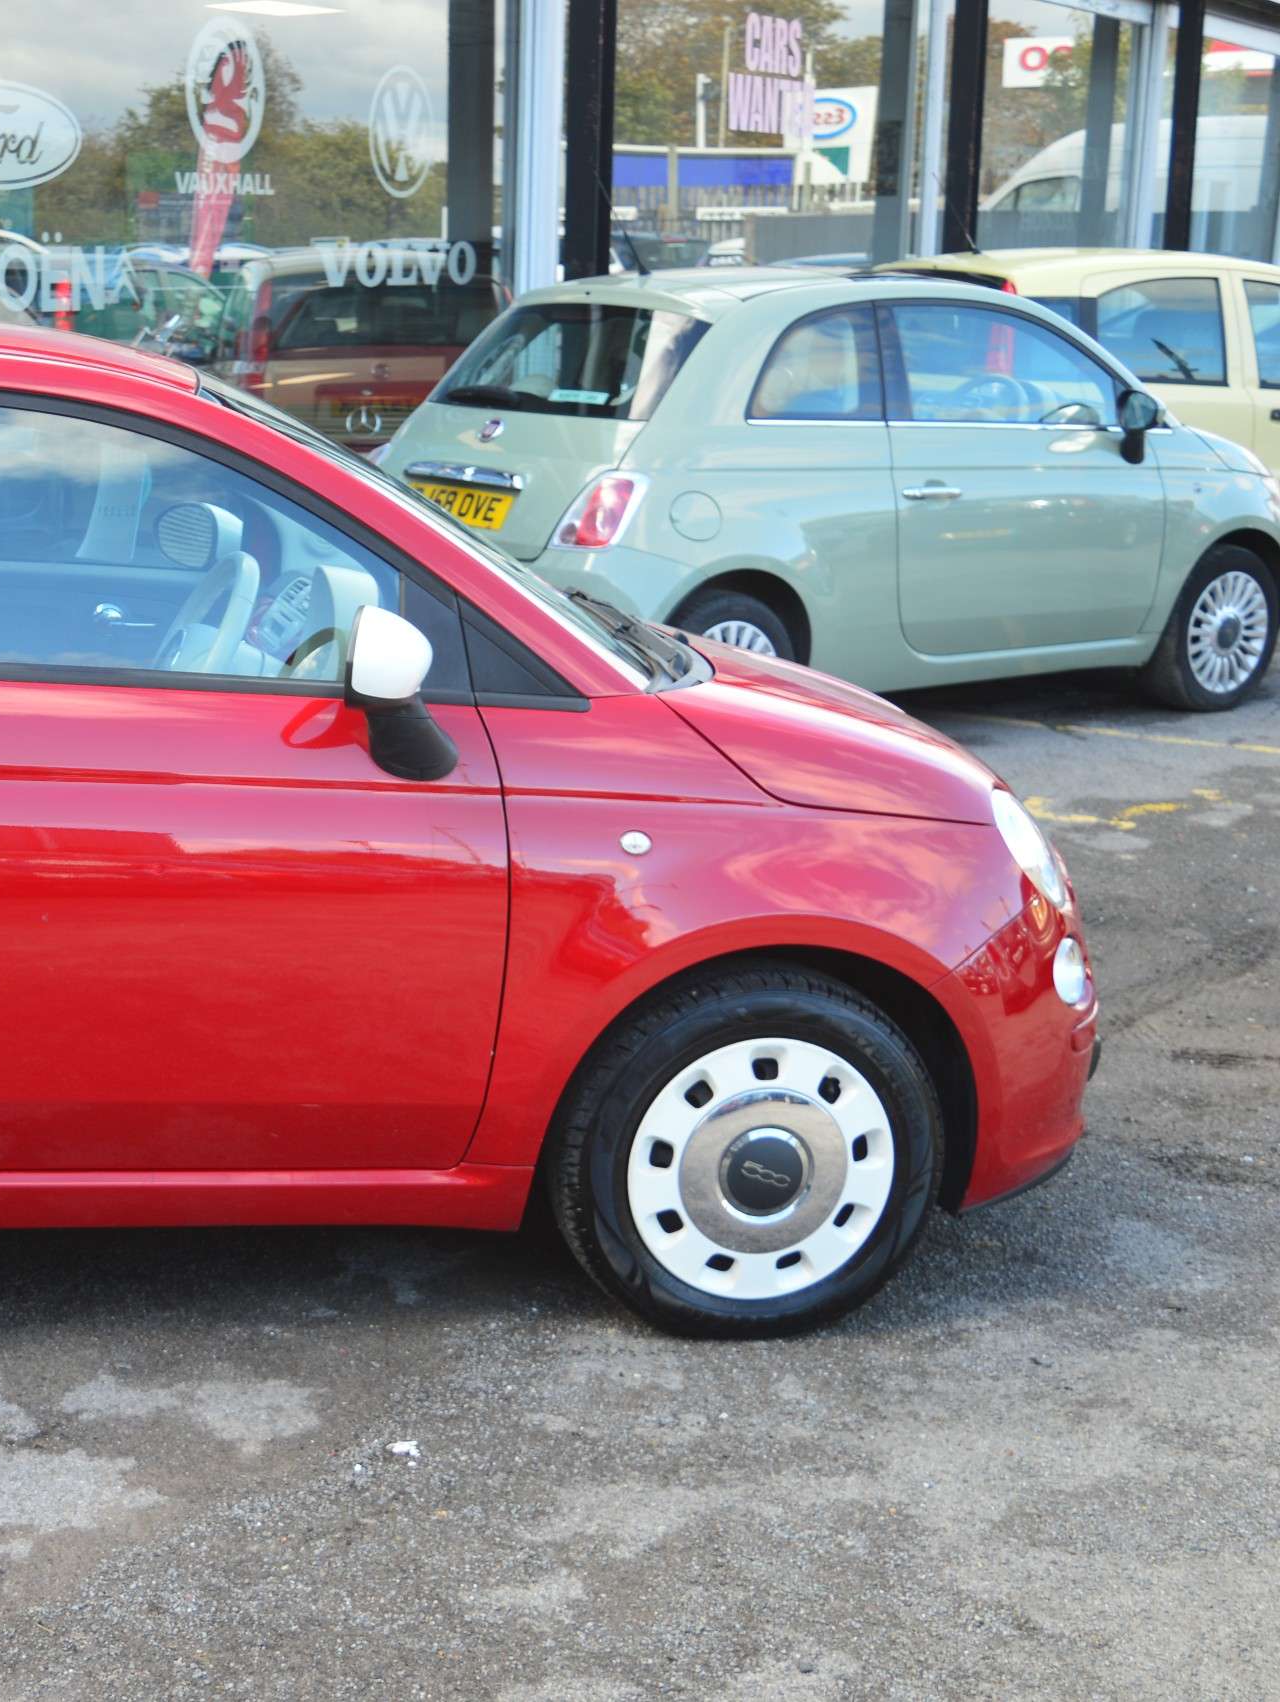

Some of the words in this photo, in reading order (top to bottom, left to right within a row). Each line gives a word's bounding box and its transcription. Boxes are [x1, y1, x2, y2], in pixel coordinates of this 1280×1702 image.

[745, 12, 802, 77] CARS
[175, 171, 275, 195] VAUXHALL
[314, 239, 477, 288] VOLVO
[740, 1160, 792, 1188] 500
